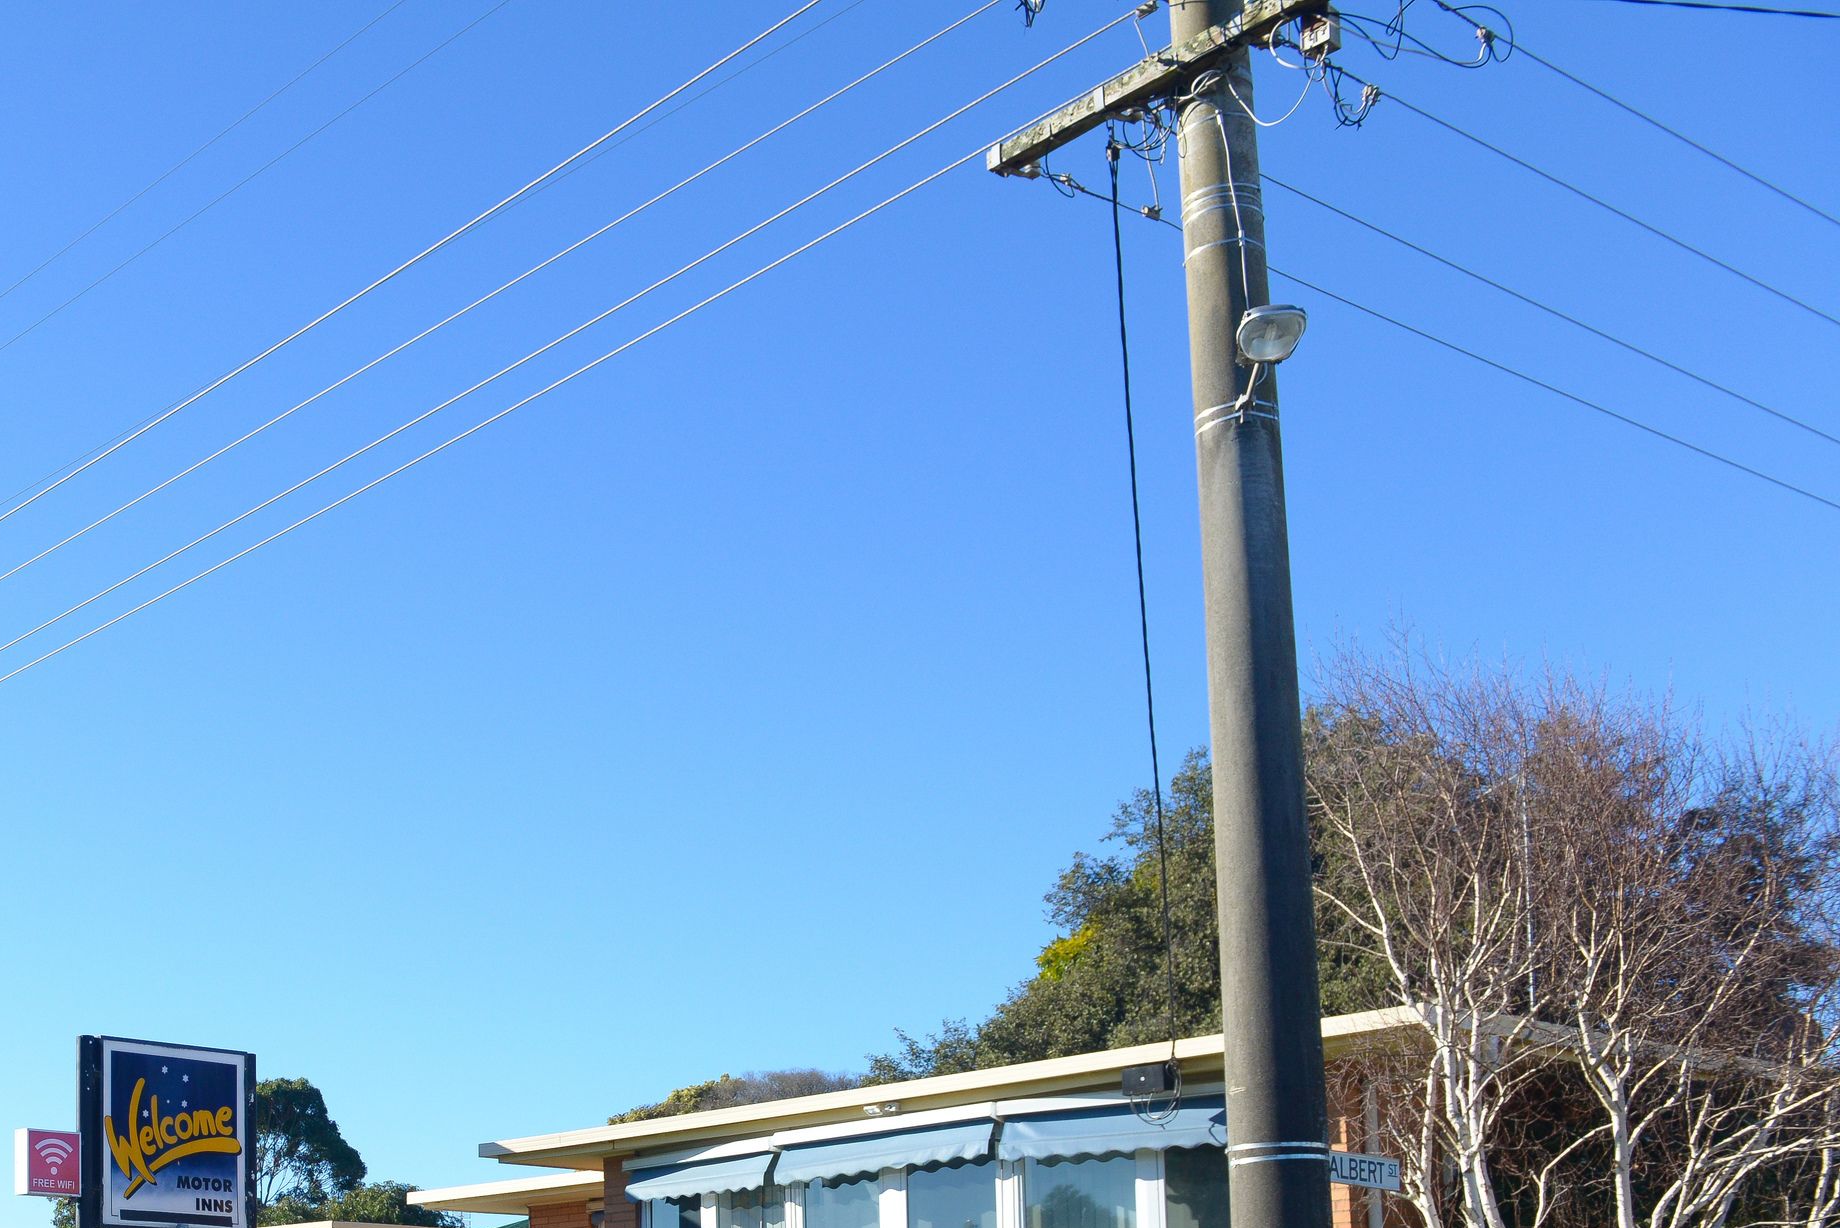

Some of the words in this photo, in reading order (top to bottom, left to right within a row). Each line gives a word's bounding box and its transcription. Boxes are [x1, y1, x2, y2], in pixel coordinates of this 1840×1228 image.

[105, 1077, 235, 1186] Welcome
[1330, 1155, 1385, 1184] ALBERT
[1388, 1163, 1398, 1176] ST
[32, 1178, 55, 1188] FREE
[57, 1180, 75, 1190] WIFI
[177, 1176, 233, 1192] MOTOR
[195, 1198, 233, 1213] INNS
